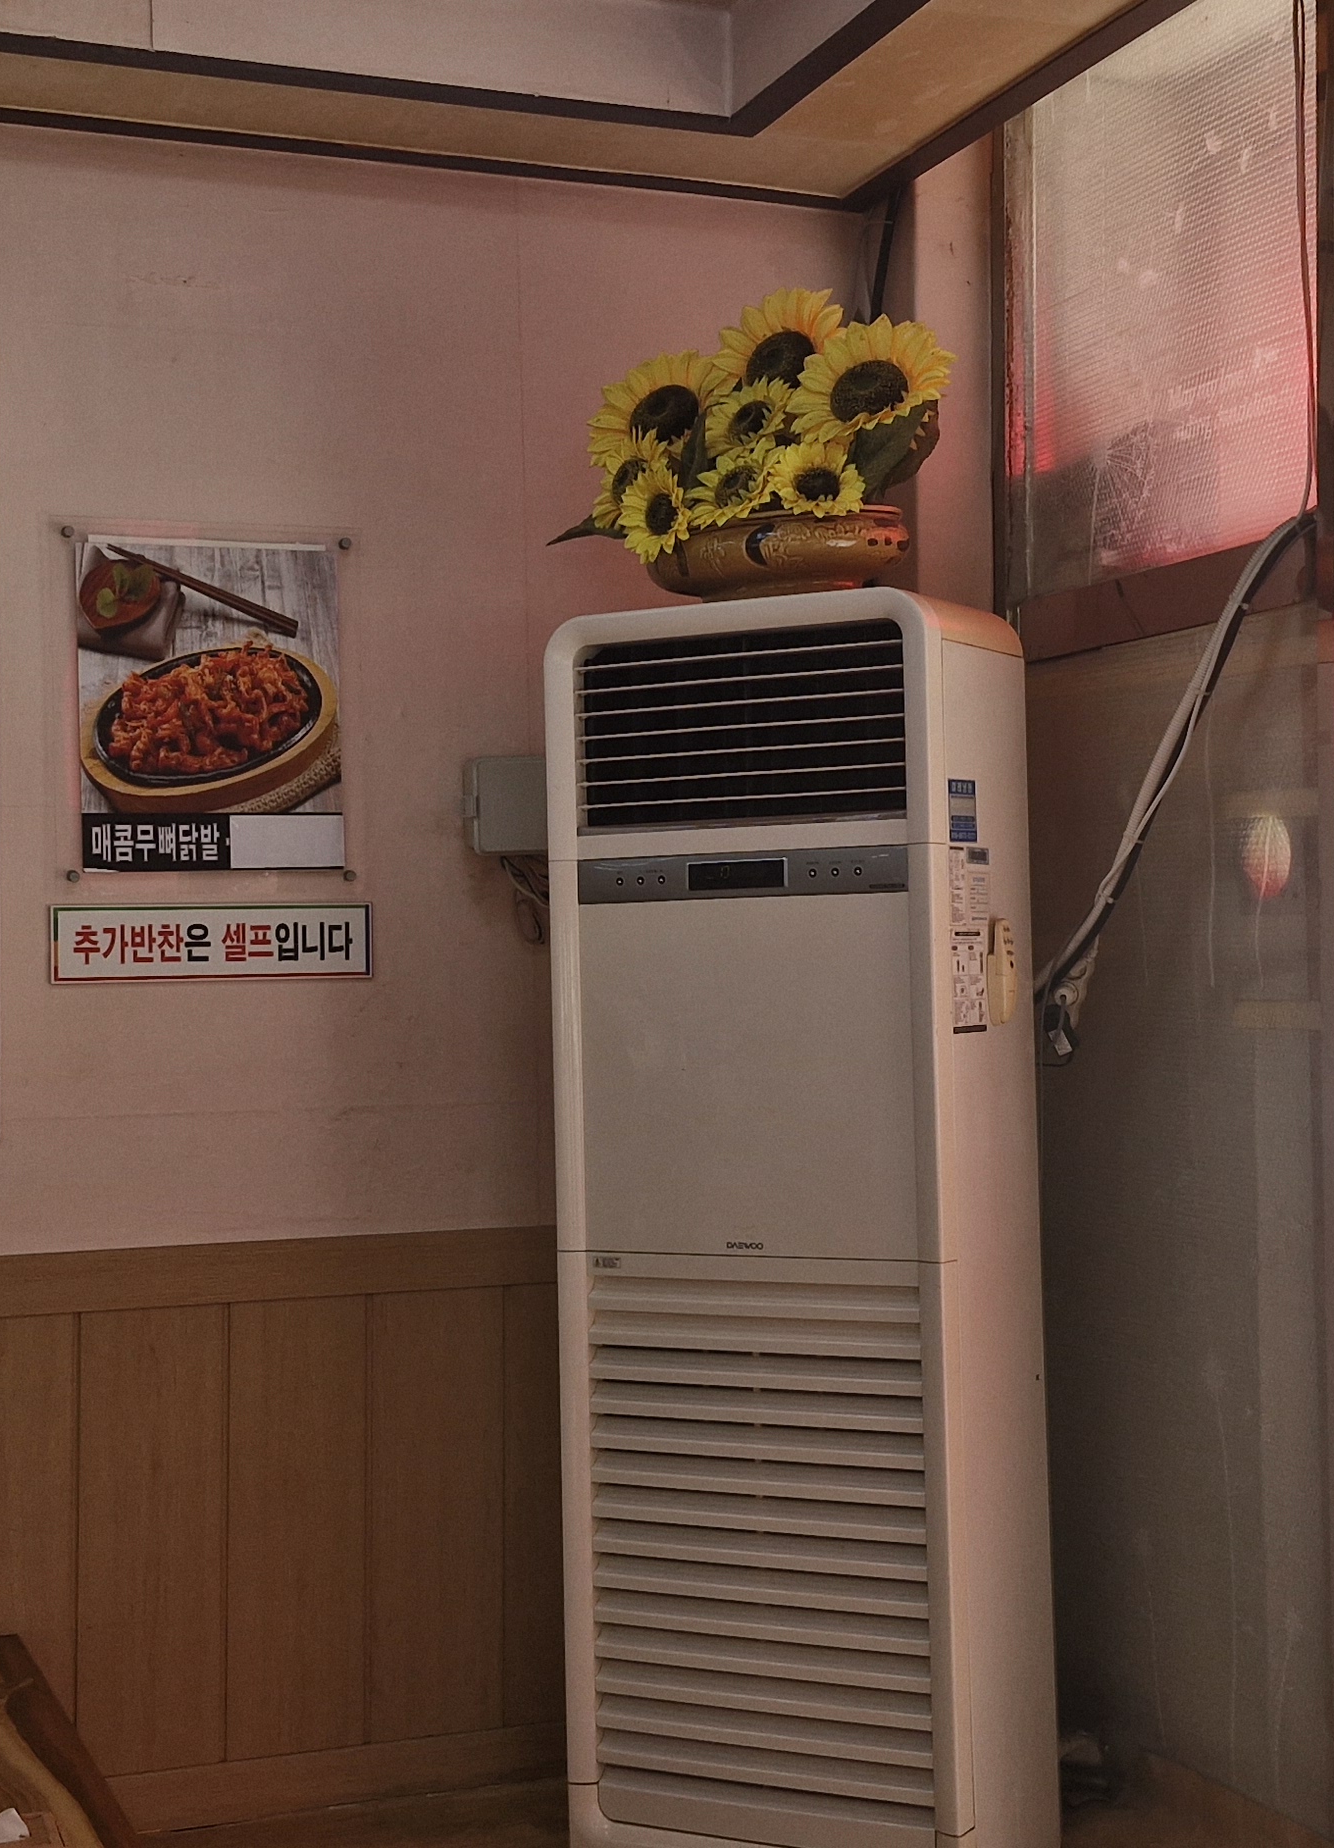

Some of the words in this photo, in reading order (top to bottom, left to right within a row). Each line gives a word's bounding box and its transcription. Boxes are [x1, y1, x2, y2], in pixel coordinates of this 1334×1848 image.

[91, 824, 220, 862] 매콤무뼈닭발
[72, 922, 212, 965] 추가반찬은
[221, 921, 354, 961] 셀프입니다
[726, 1241, 764, 1250] DAEWOO
